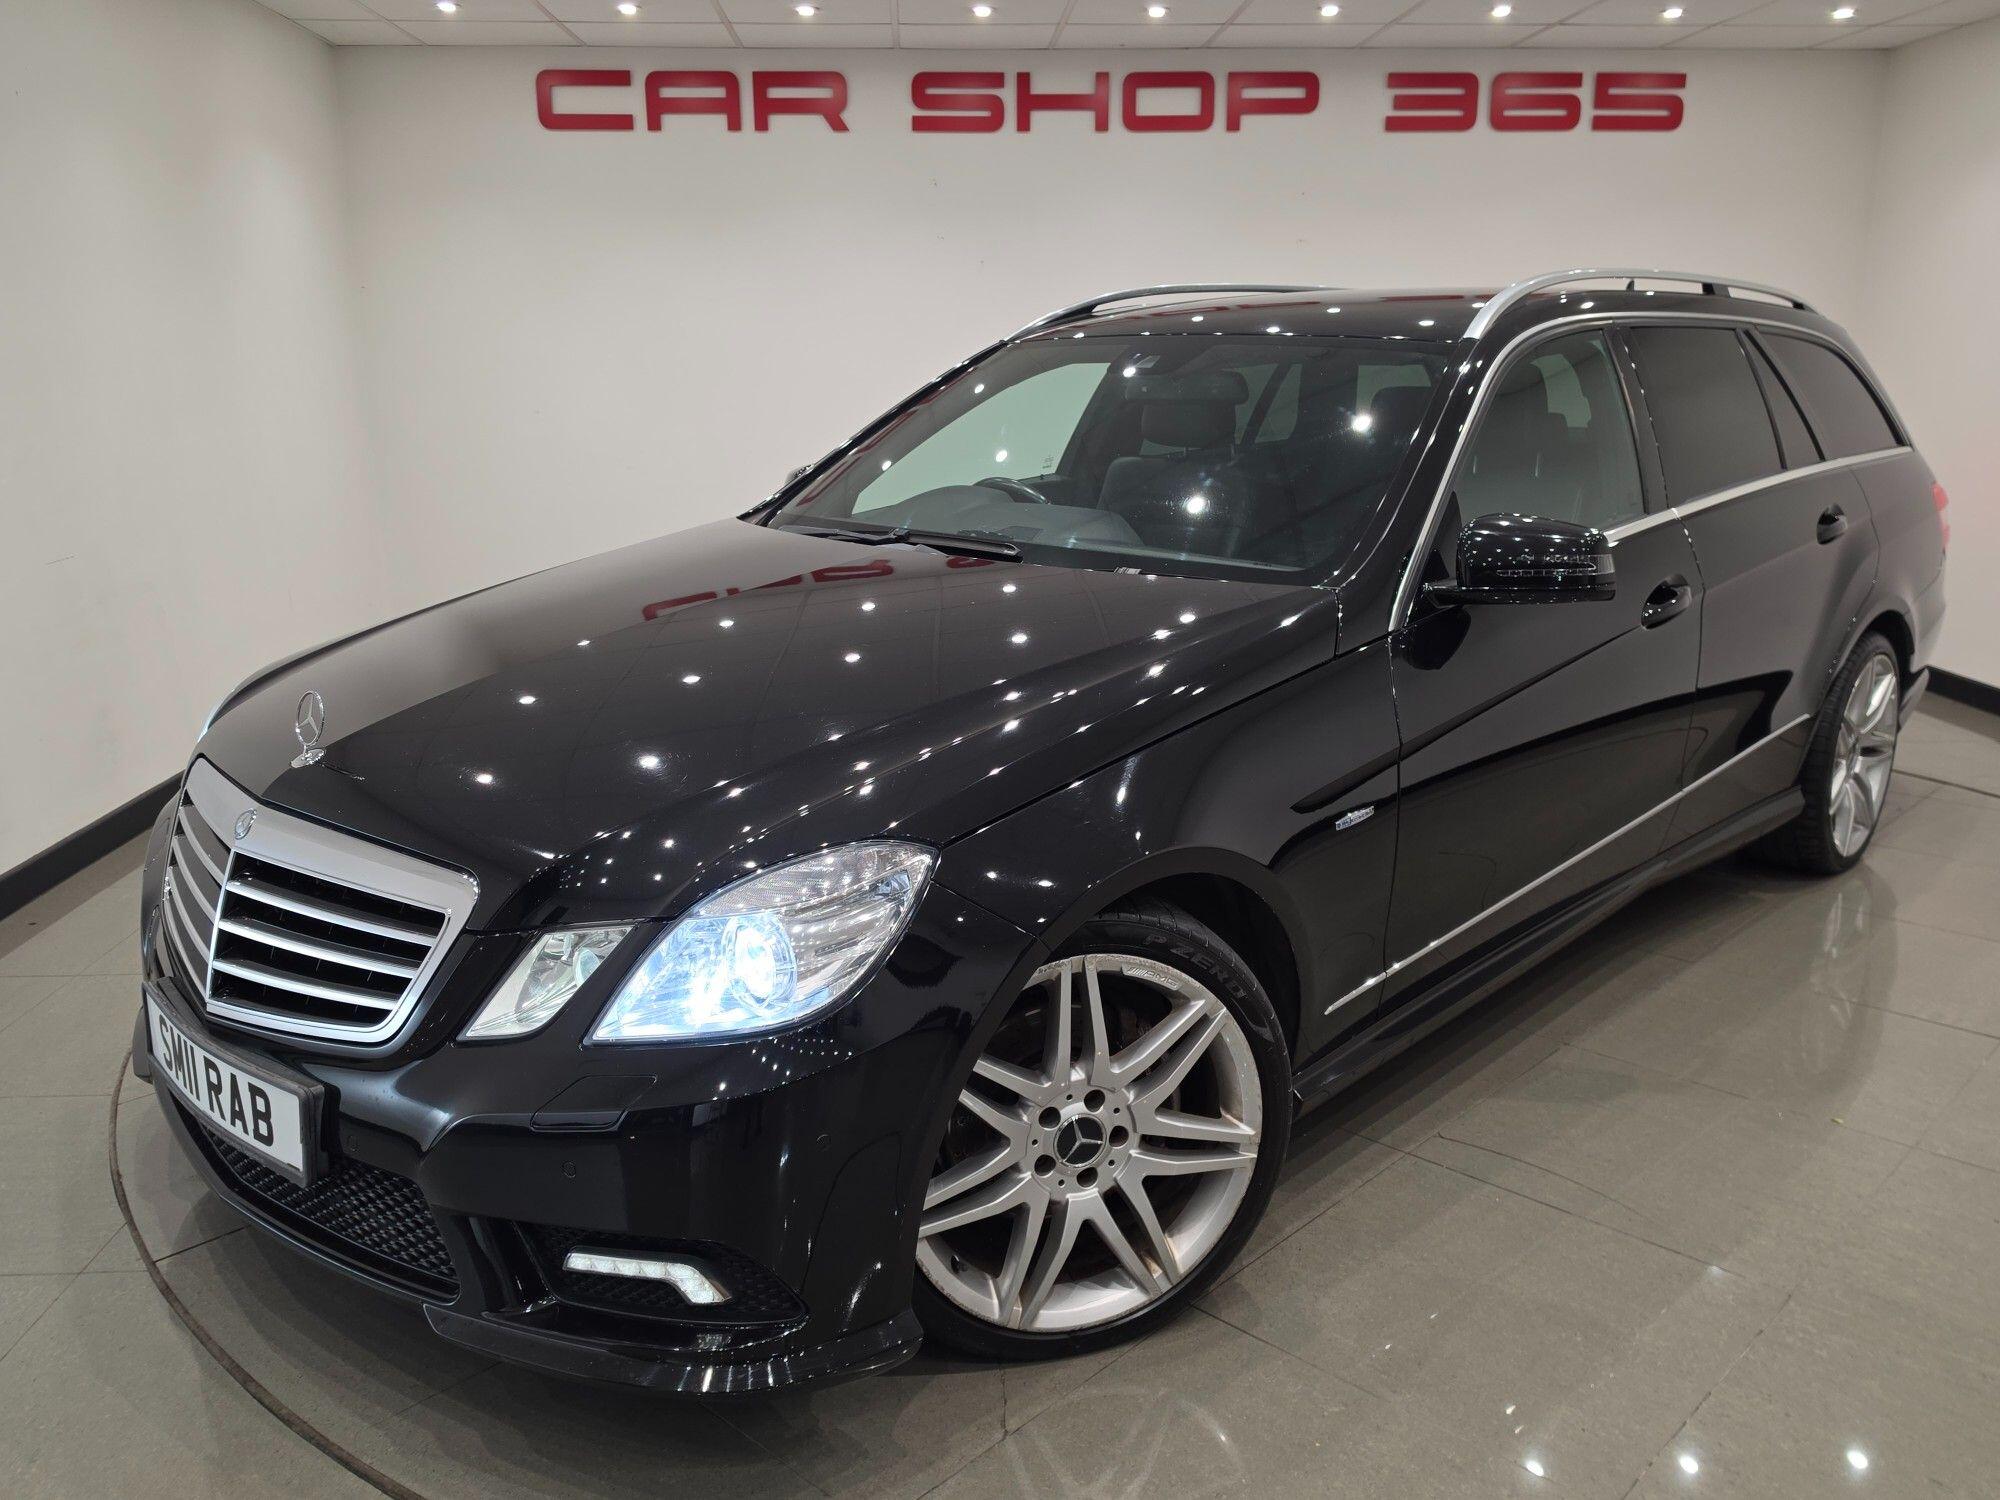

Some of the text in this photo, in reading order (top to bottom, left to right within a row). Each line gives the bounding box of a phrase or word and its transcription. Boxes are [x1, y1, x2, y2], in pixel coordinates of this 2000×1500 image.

[536, 69, 1687, 132] CAR SHOP 365
[158, 1013, 275, 1147] SM11 RAB
